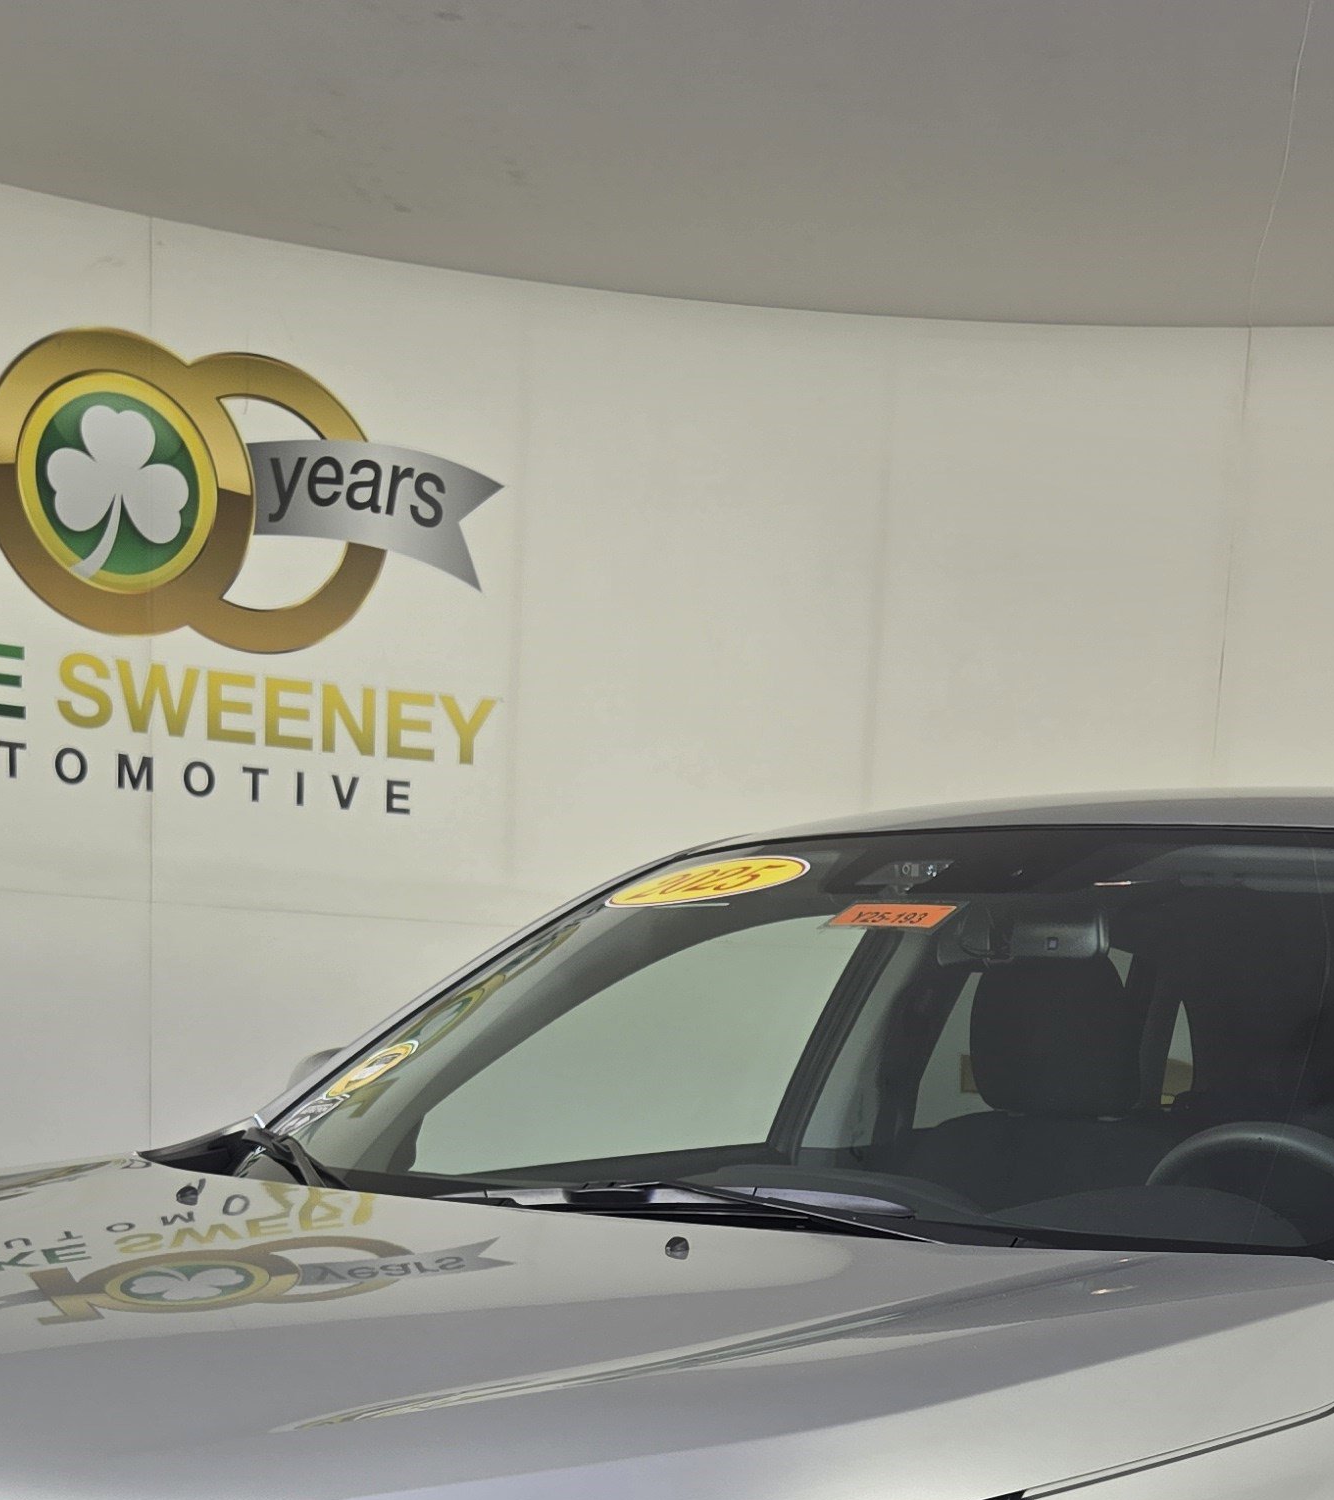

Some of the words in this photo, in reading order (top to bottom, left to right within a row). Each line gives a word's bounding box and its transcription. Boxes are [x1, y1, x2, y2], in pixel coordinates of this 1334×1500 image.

[268, 453, 447, 528] years
[57, 652, 496, 766] SWEENEY
[623, 864, 787, 901] 2025
